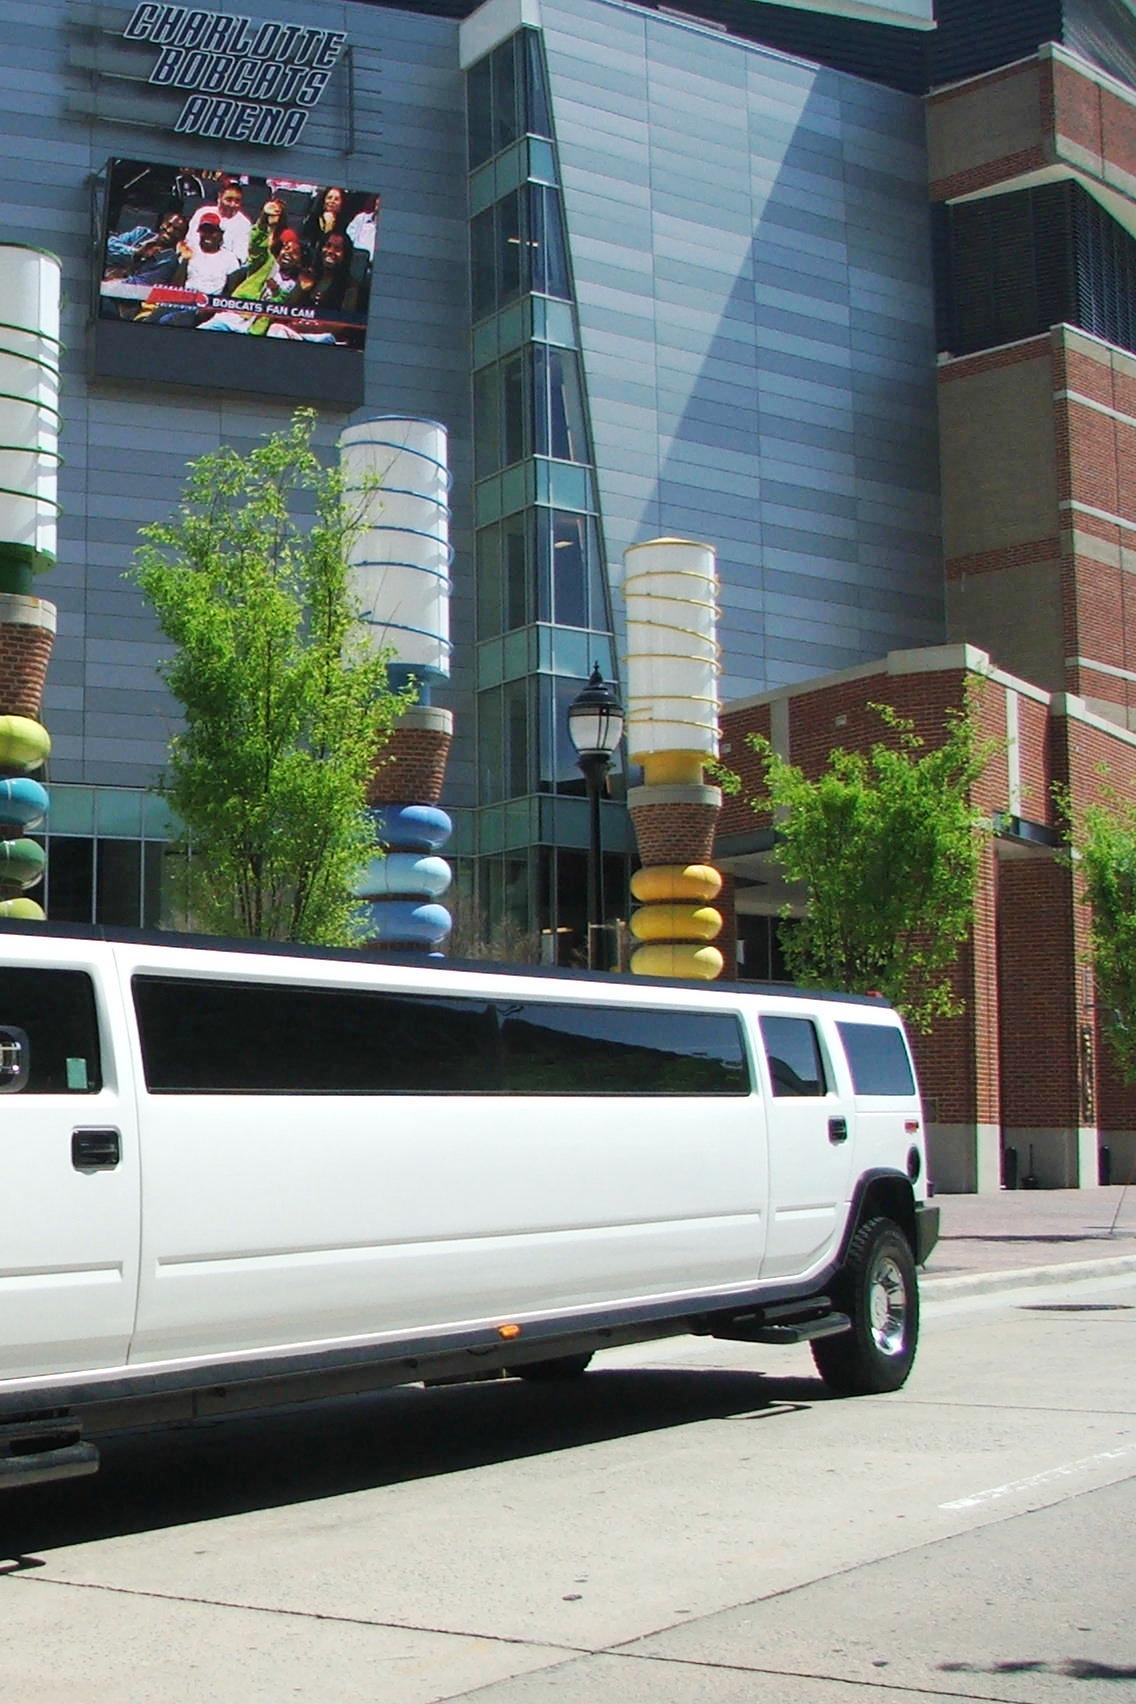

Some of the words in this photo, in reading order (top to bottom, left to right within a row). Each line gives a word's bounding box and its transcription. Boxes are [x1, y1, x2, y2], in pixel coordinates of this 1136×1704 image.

[123, 1, 348, 70] CHARLOTTE
[148, 46, 332, 107] BOBCATS
[174, 94, 309, 147] ARENA
[212, 297, 263, 313] BOBCATS
[266, 304, 289, 316] FAN
[291, 307, 315, 319] CAM
